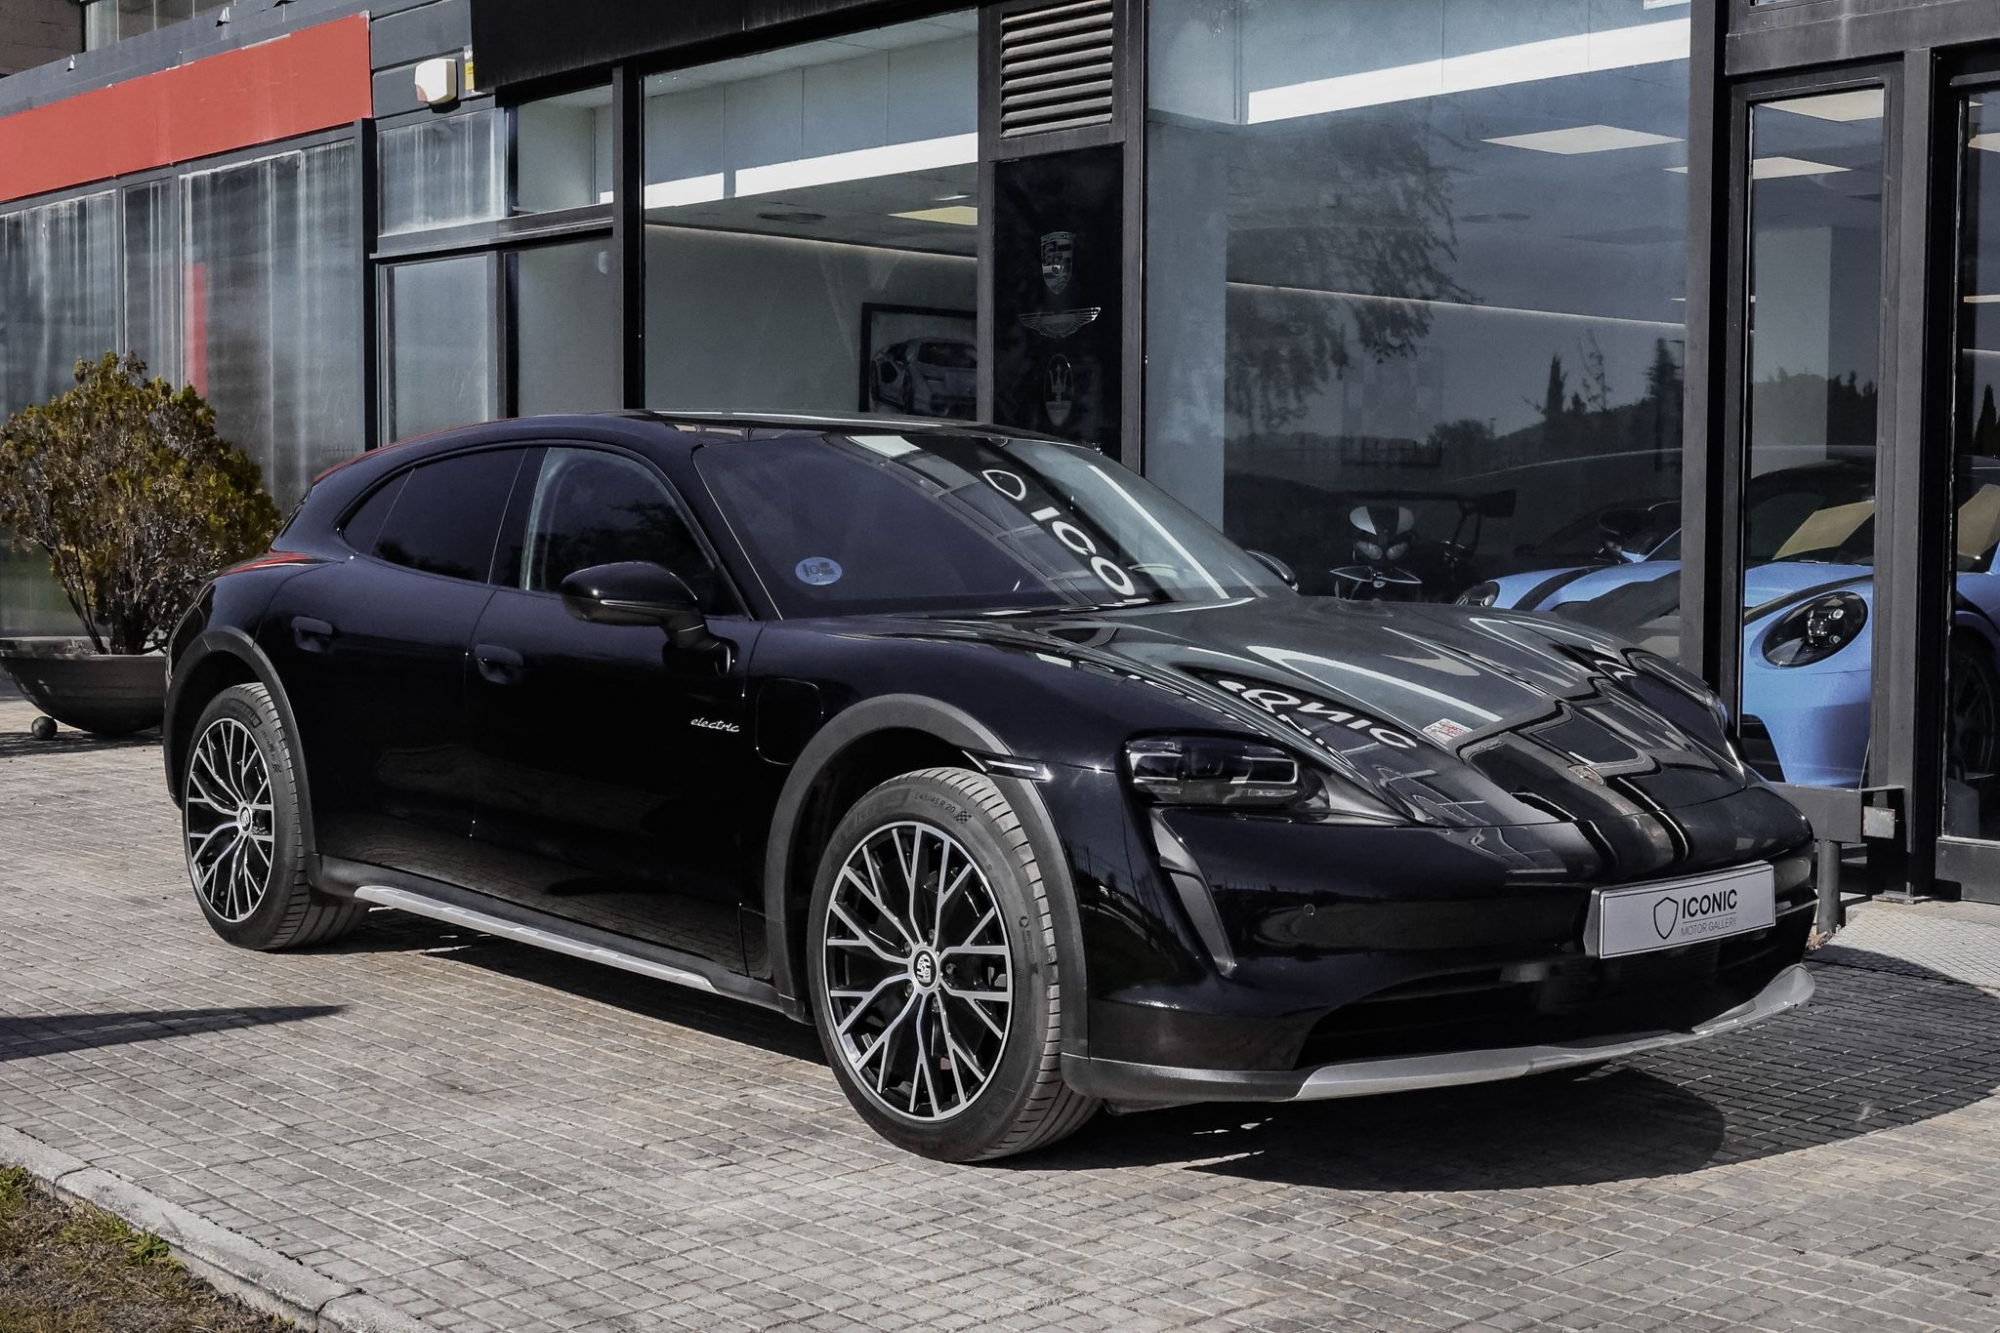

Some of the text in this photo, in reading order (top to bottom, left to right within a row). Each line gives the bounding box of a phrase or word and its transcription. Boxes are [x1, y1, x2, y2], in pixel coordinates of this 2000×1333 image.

[690, 717, 740, 732] electric
[945, 803, 956, 813] 20
[1682, 889, 1737, 918] ICONIC
[1681, 917, 1737, 937] MOTOR GALLERY
